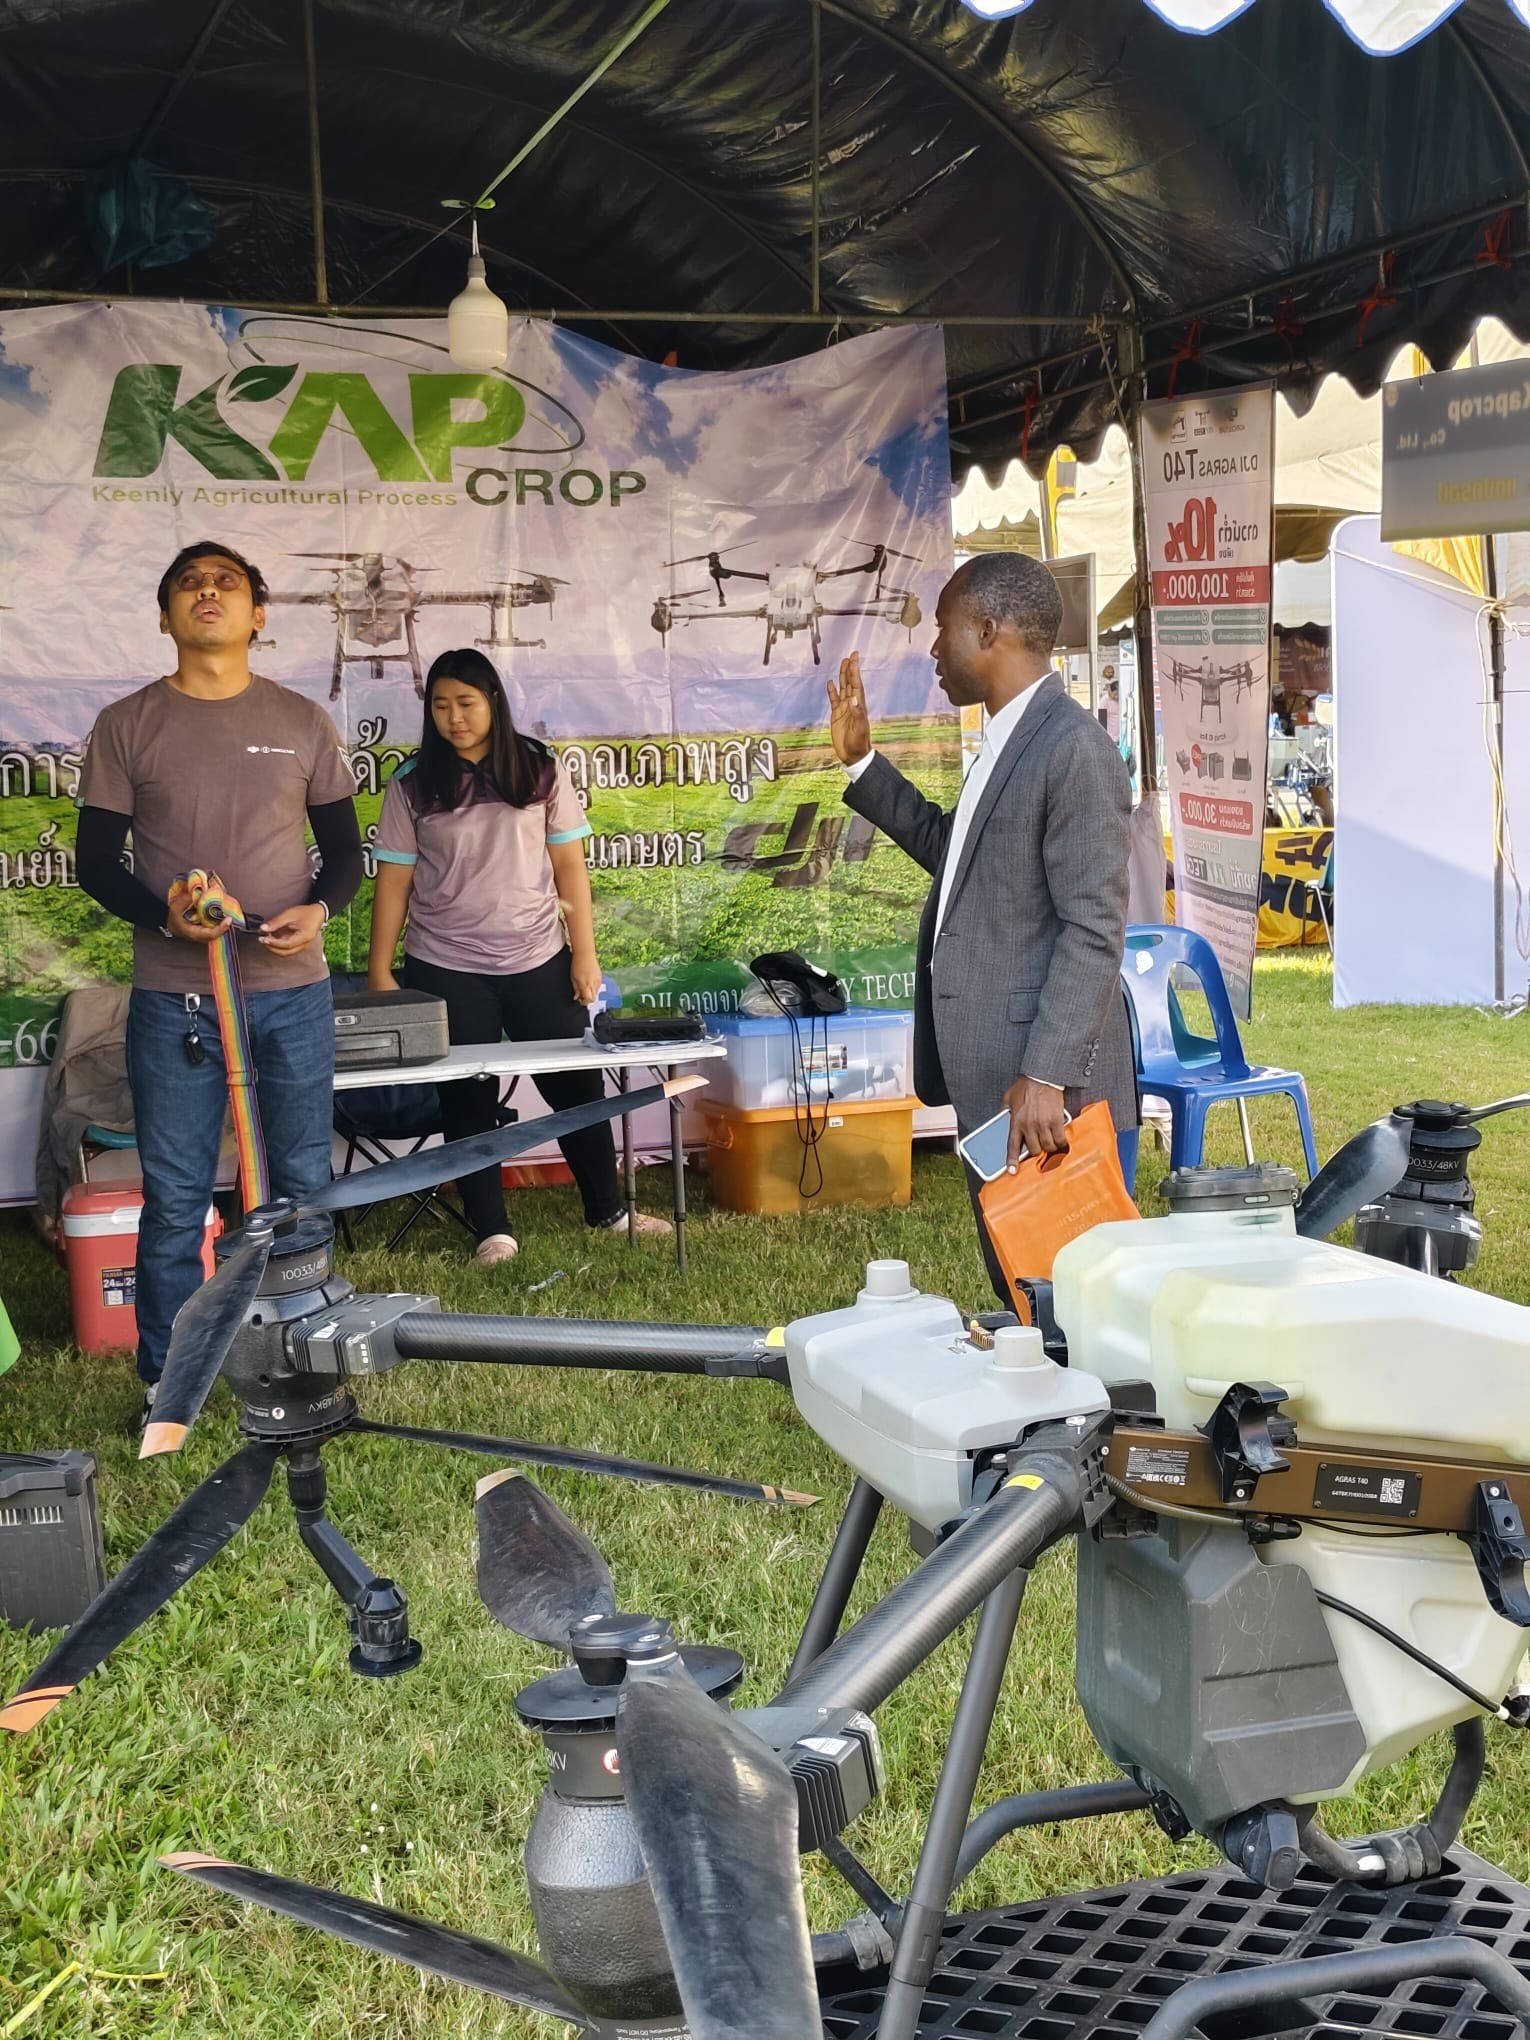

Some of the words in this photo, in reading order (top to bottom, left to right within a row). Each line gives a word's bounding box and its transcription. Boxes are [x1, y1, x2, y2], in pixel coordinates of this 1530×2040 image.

[92, 363, 526, 482] KAP
[92, 486, 184, 507] Keenly
[193, 486, 348, 507] Agricultural
[358, 489, 457, 506] Process
[466, 468, 646, 506] CROP
[862, 972, 916, 1001] TECH
